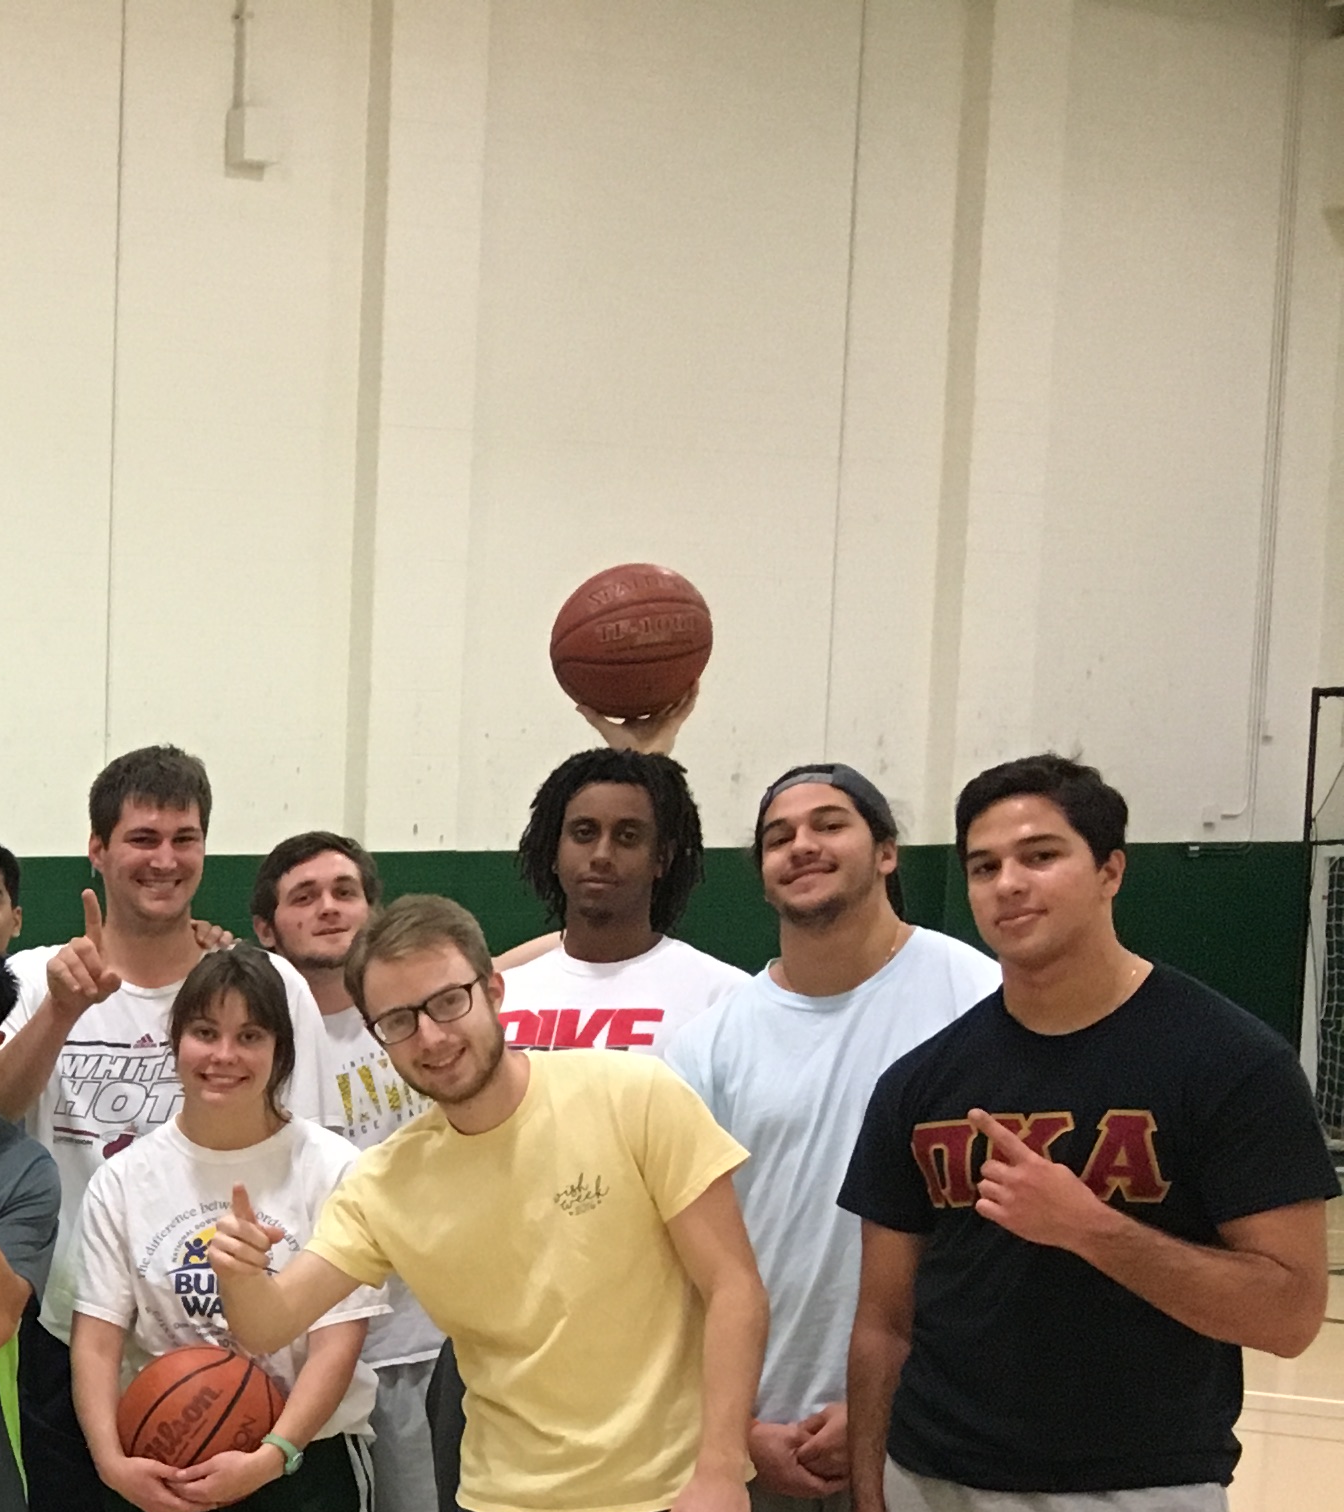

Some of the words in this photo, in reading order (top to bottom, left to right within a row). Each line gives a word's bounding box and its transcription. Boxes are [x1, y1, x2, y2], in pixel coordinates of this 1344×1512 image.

[61, 1050, 179, 1082] WHITE
[53, 1076, 186, 1124] HOT
[145, 1206, 197, 1255] difference
[200, 1199, 232, 1214] betw
[181, 1296, 224, 1318] WA
